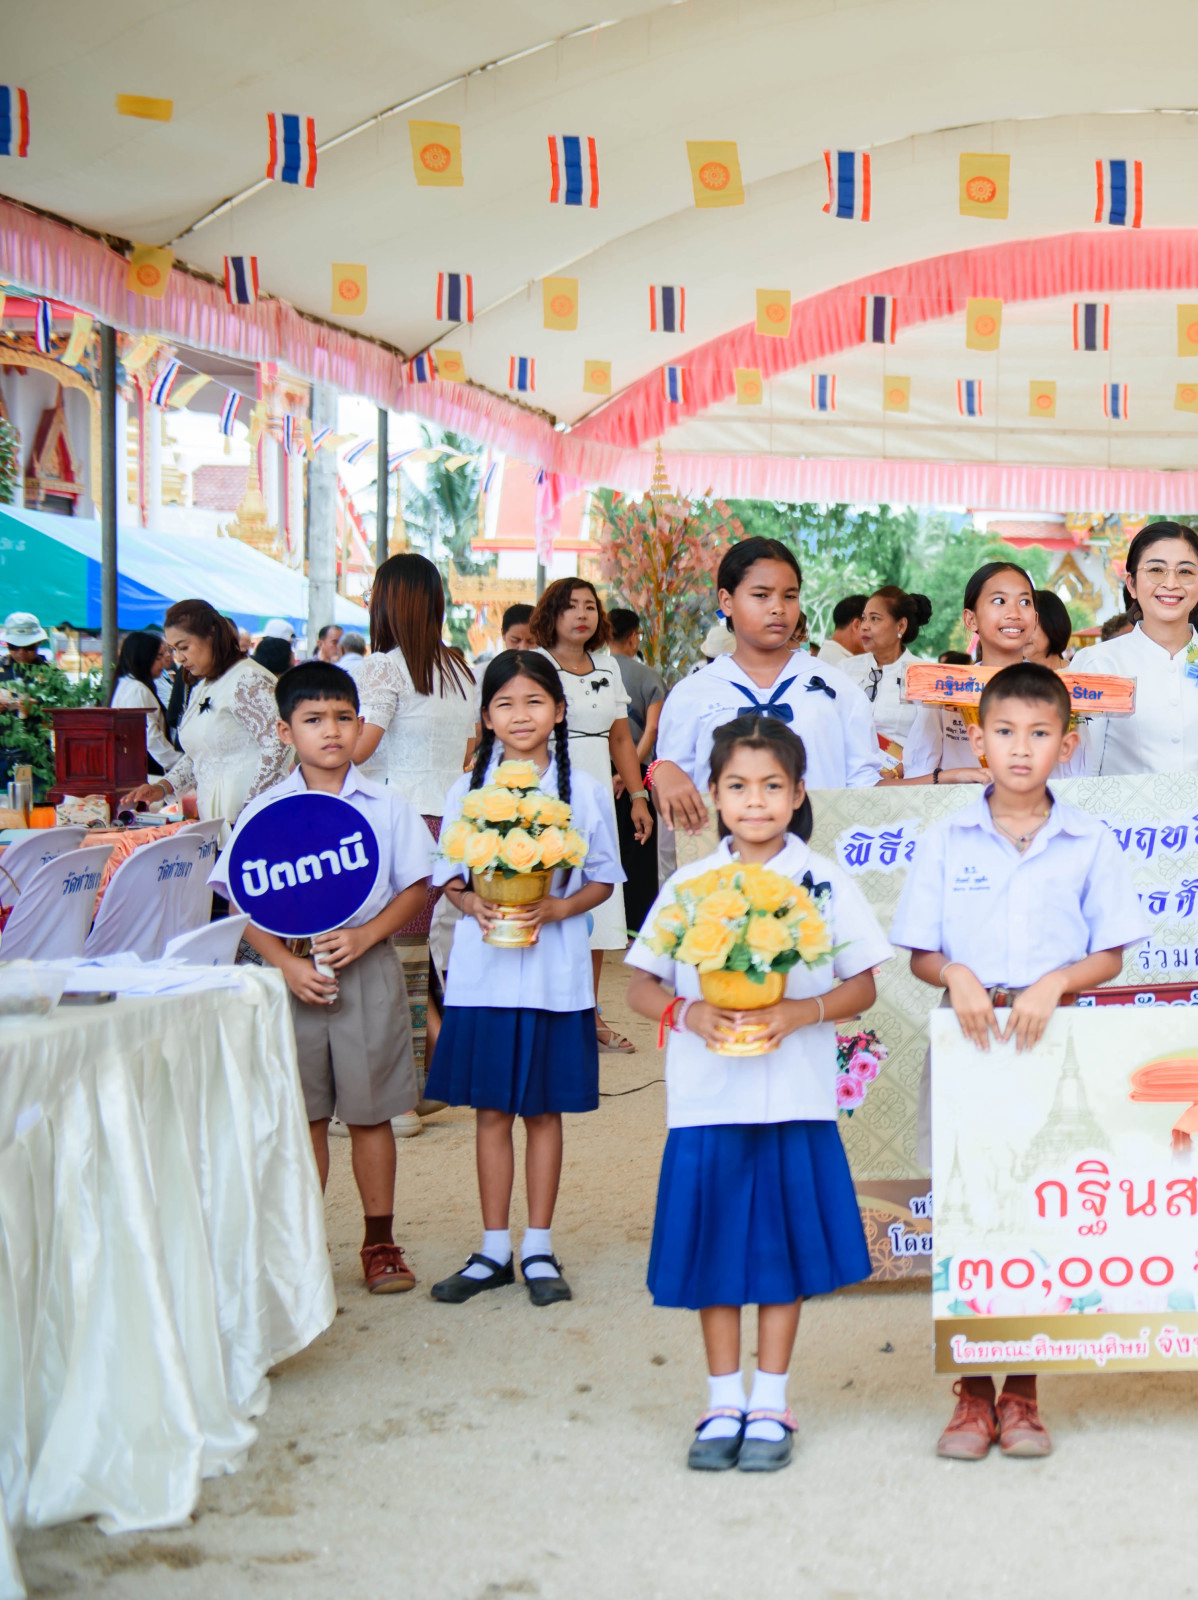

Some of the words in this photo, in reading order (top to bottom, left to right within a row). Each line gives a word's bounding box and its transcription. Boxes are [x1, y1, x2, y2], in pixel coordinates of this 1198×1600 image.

[935, 675, 985, 696] กฐินสัม
[241, 830, 370, 898] ปัตตานี
[957, 1255, 1175, 1297] ๓๐,๐๐๐
